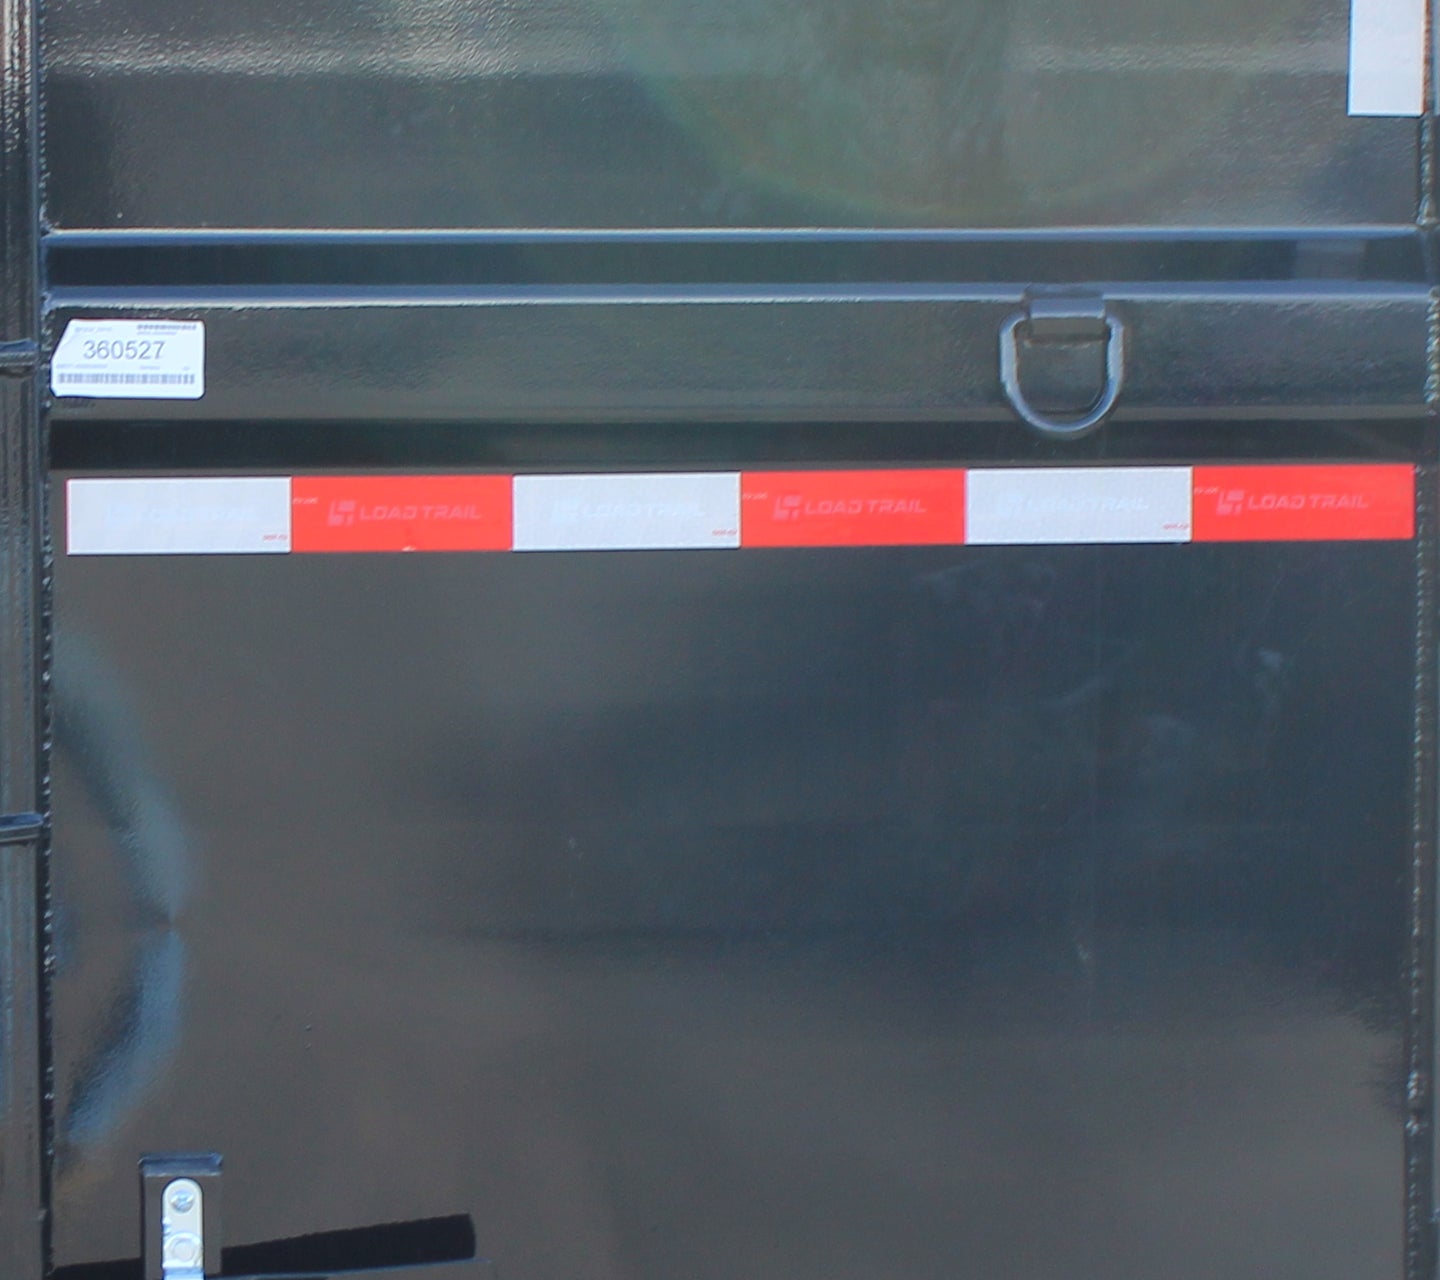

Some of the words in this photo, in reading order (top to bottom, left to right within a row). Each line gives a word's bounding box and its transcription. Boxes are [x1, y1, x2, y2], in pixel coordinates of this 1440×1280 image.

[83, 340, 165, 360] 360527
[804, 500, 864, 515] LOAD
[868, 499, 928, 513] TRAIL
[1248, 494, 1307, 510] LOAD
[1309, 494, 1372, 509] TRAIL
[359, 505, 419, 520] LOAD
[422, 505, 483, 520] TRAIL
